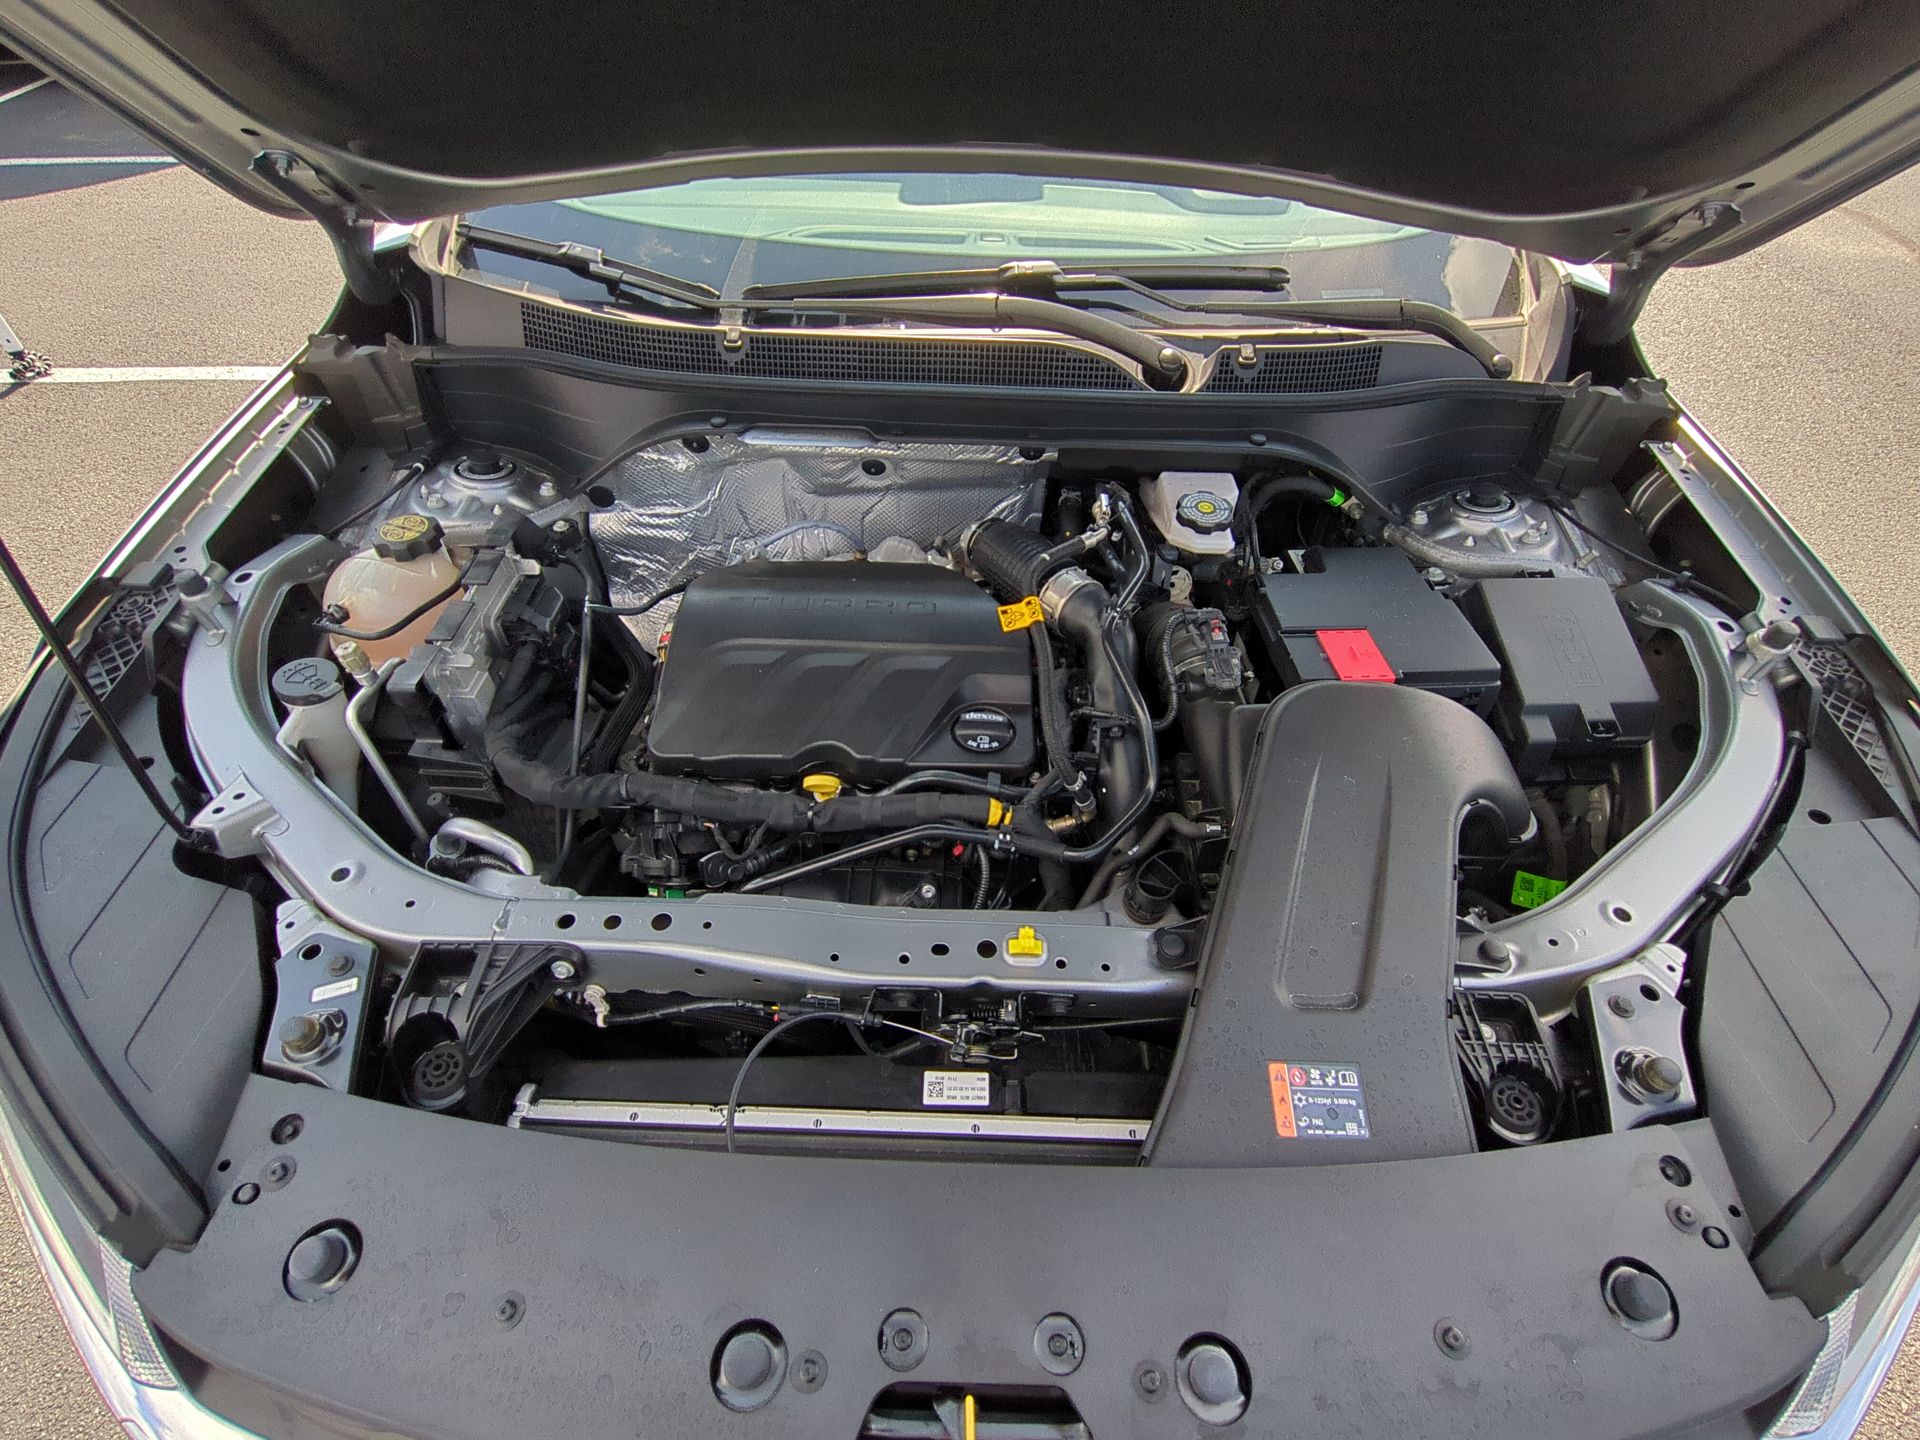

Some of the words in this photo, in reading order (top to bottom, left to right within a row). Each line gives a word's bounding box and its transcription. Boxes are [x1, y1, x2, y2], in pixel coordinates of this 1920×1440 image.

[728, 596, 937, 616] TURBO
[965, 712, 1003, 721] dexos
[1312, 1118, 1324, 1126] PAG
